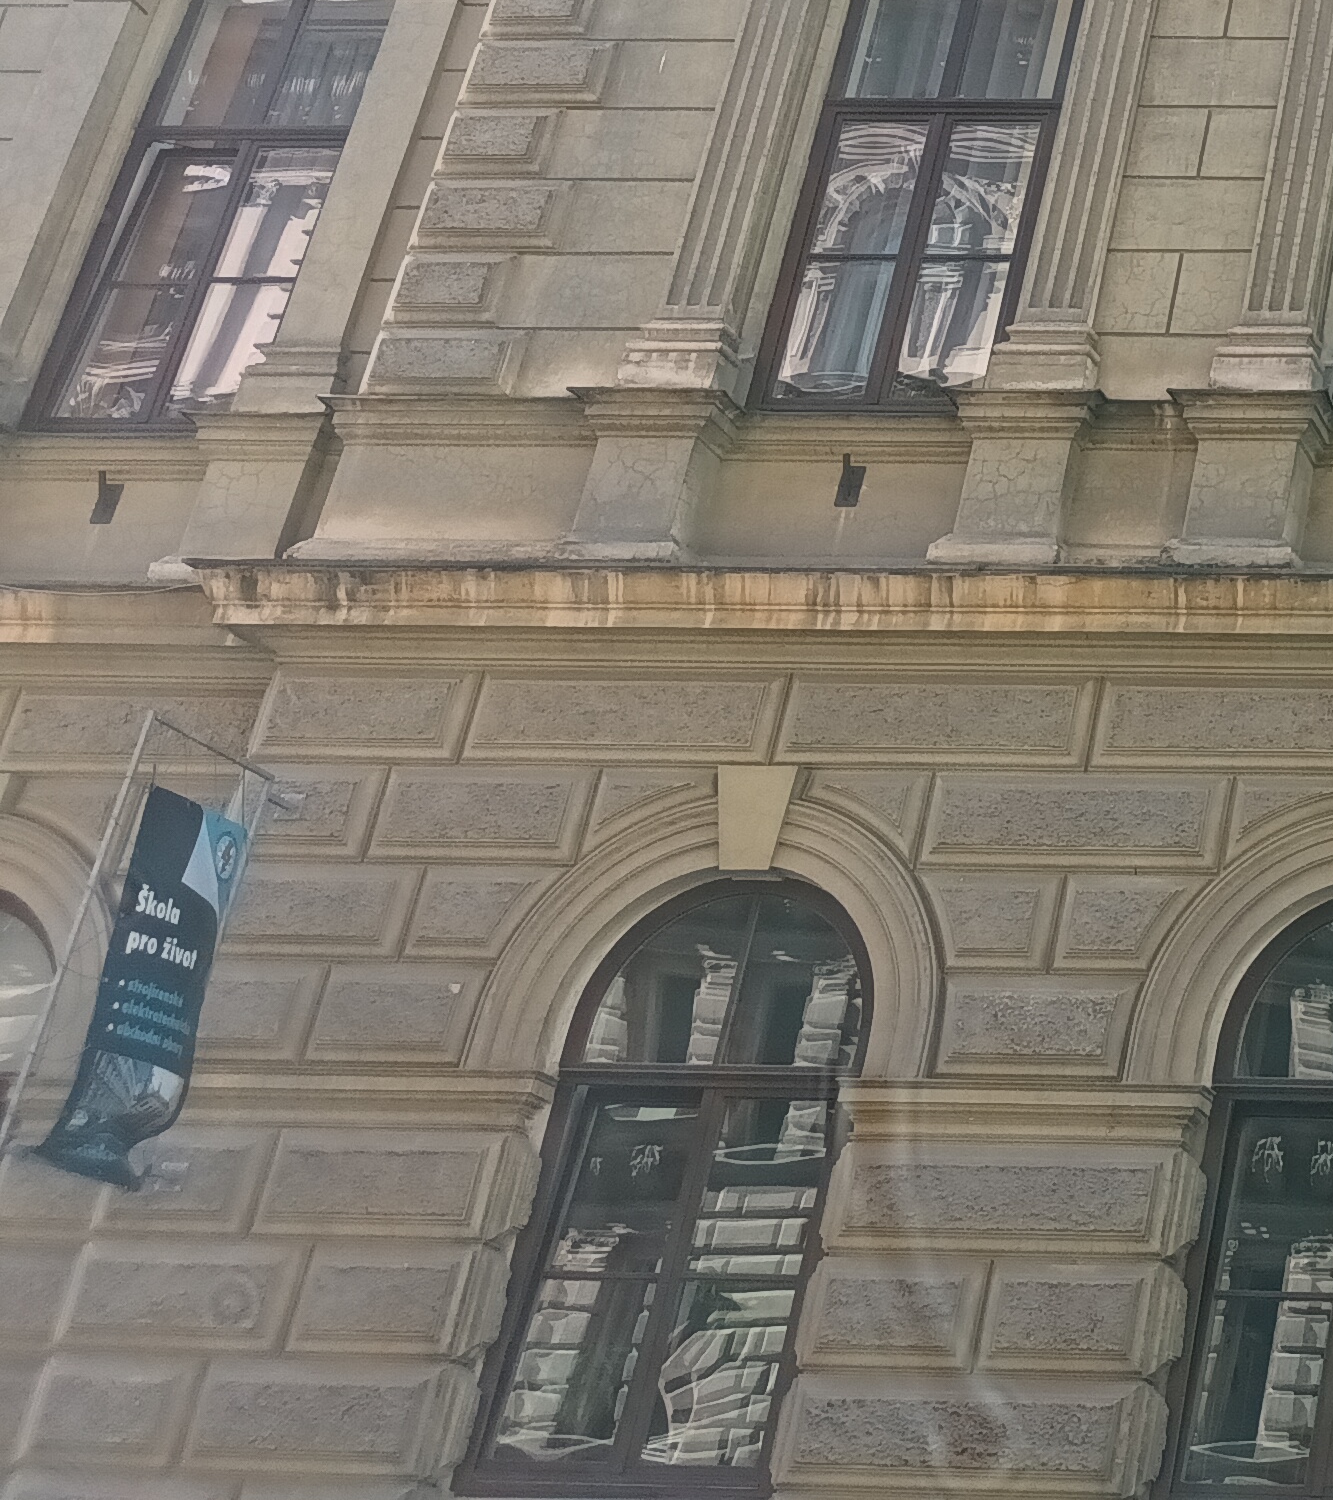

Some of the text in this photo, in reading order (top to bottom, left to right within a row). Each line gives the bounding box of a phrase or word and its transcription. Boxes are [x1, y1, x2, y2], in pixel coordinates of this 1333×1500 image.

[136, 884, 181, 925] Škola
[125, 931, 198, 970] pro život
